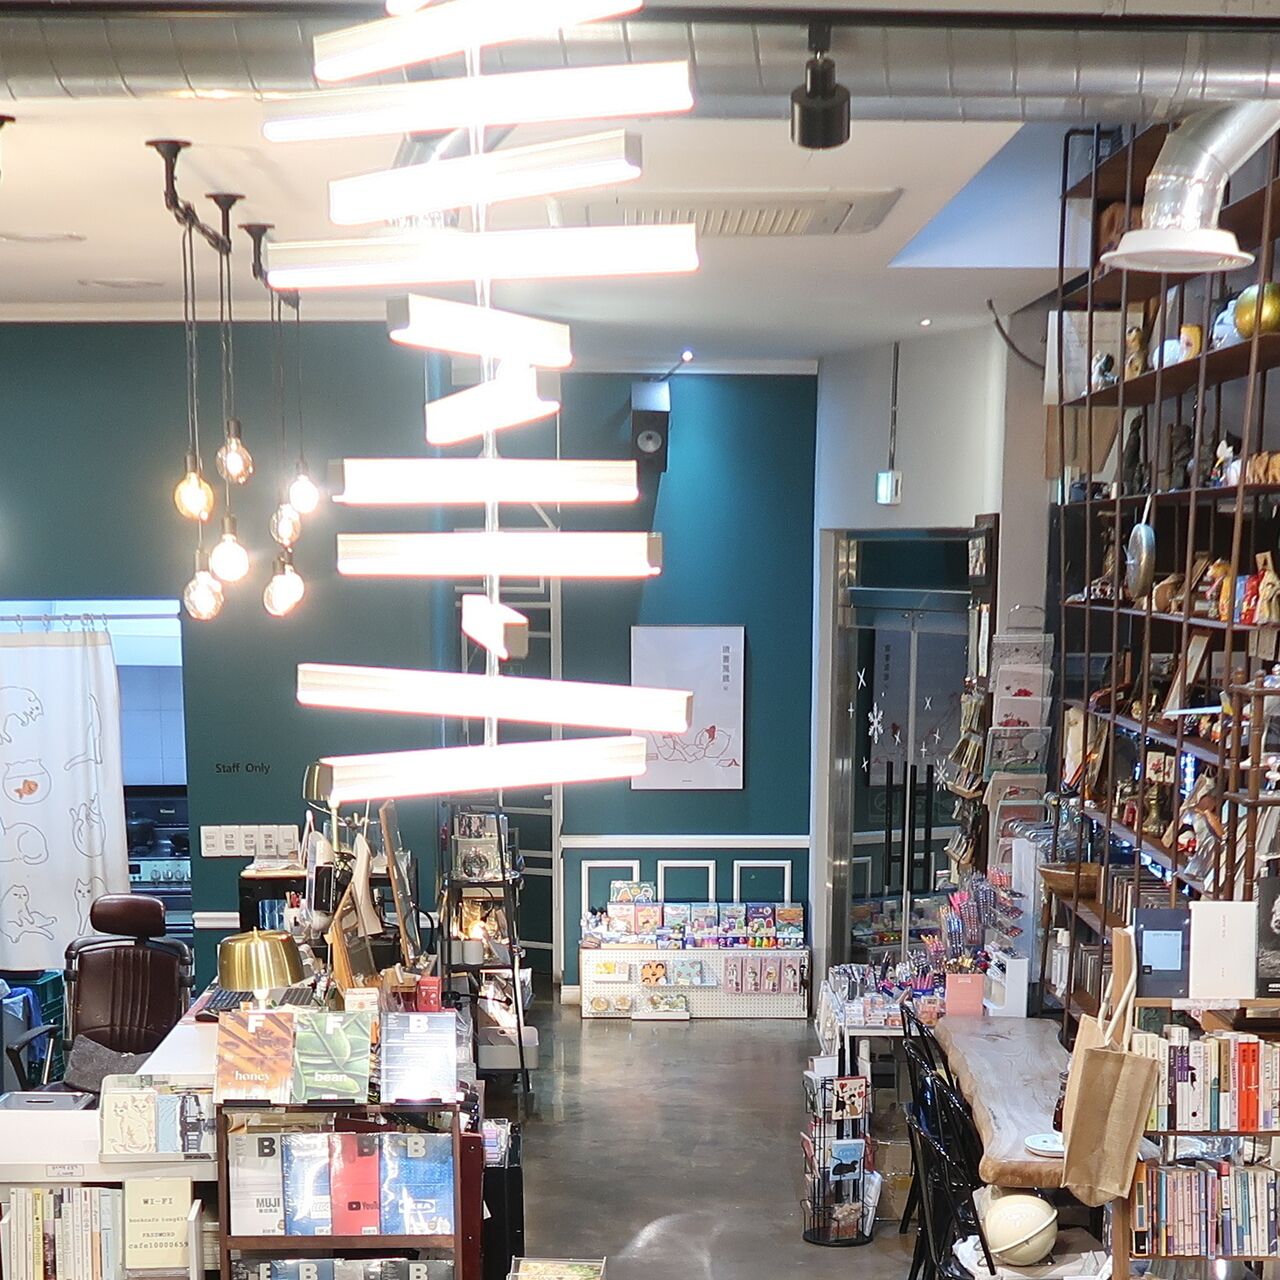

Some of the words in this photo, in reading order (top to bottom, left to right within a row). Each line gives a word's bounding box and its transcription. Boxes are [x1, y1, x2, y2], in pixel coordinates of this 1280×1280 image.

[216, 763, 240, 774] Staff
[245, 763, 271, 775] Only
[247, 1014, 267, 1034] F
[325, 1016, 344, 1035] F
[408, 1014, 429, 1034] B
[235, 1070, 270, 1083] honey
[314, 1071, 348, 1082] bean
[257, 1137, 276, 1158] B
[407, 1135, 426, 1158] B
[142, 1197, 173, 1205] WI-FI
[256, 1198, 281, 1208] MUJI
